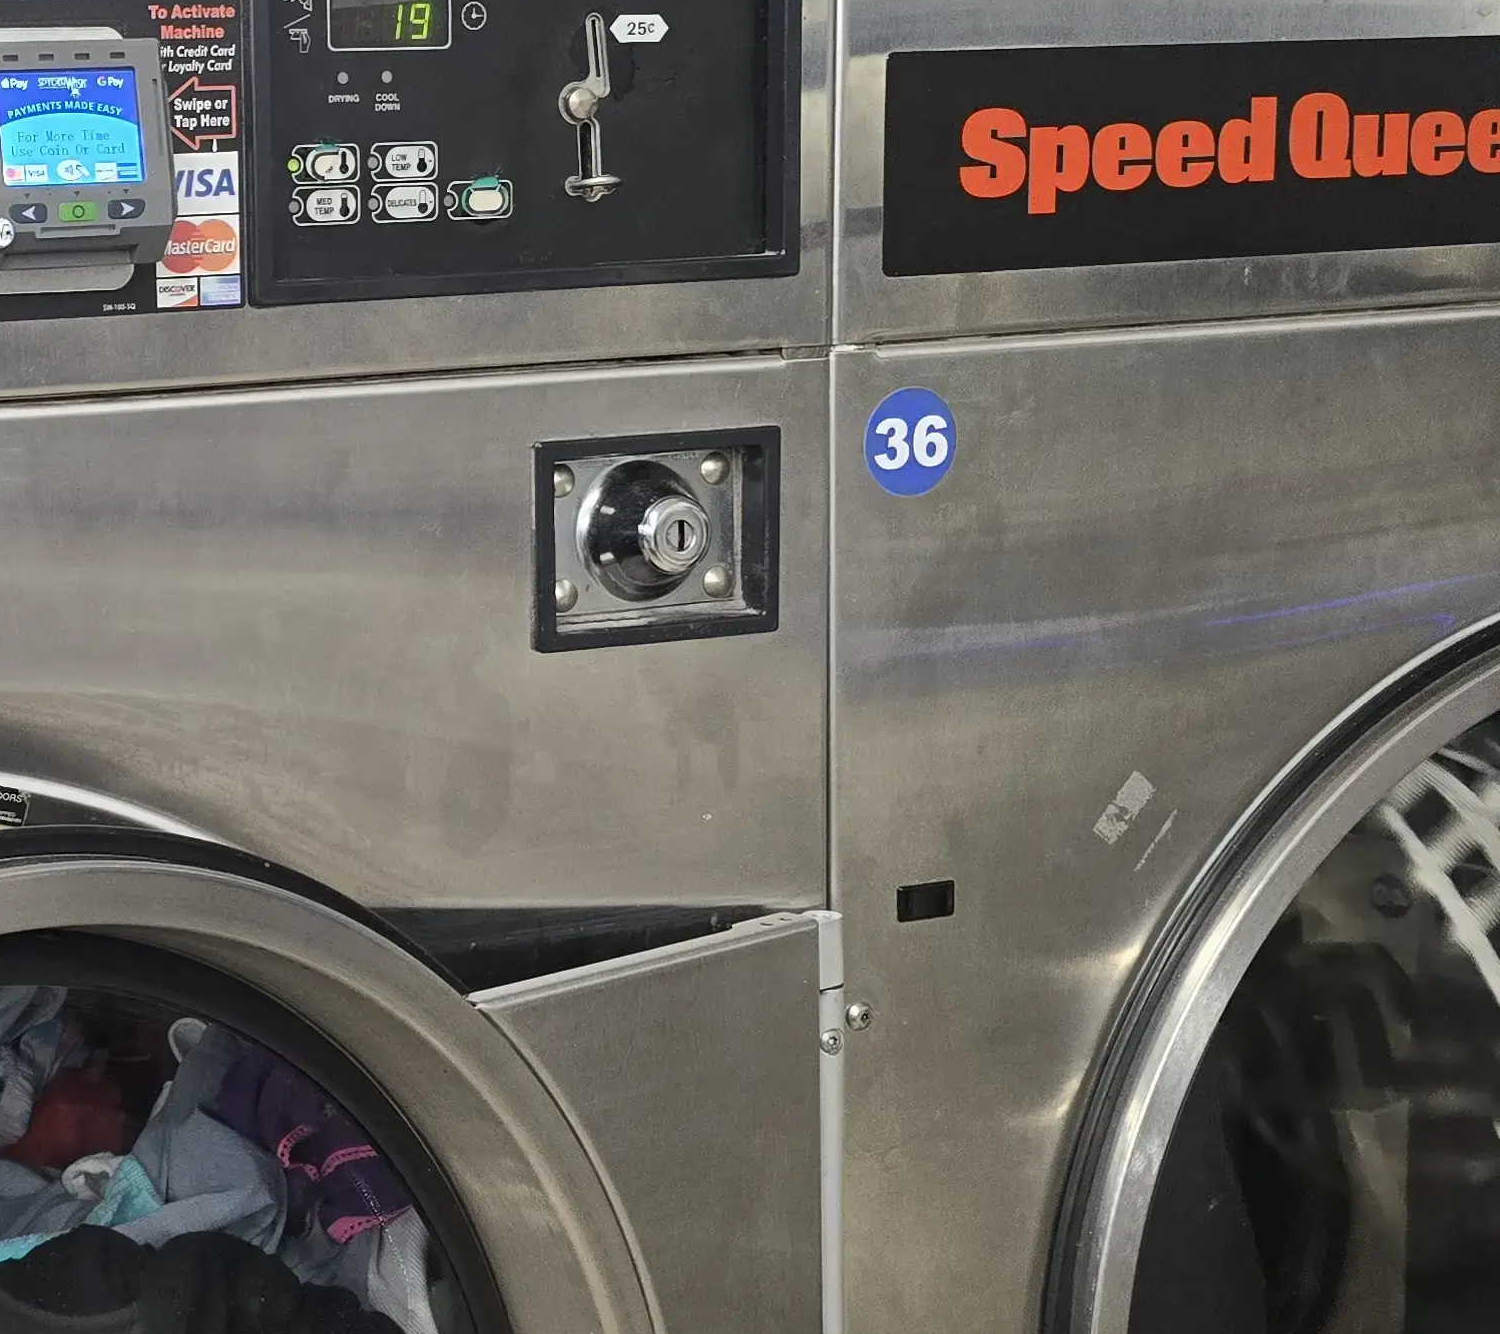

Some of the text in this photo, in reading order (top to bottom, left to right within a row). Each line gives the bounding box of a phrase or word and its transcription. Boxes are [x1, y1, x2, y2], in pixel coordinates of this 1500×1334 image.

[148, 4, 236, 19] To Activate
[395, 3, 431, 40] 19
[160, 25, 225, 39] Machine
[160, 44, 236, 58] ith Credit Card
[168, 60, 205, 74] Loyalty
[207, 58, 232, 71] Card
[328, 94, 360, 103] DRYING
[375, 93, 399, 101] COOL
[8, 100, 123, 119] PAYMENTS MADE EASY
[174, 98, 228, 113] Swipe or
[375, 103, 400, 112] DOWN
[174, 114, 230, 130] Tap Here
[17, 129, 109, 142] For More Time
[11, 143, 125, 156] Use Coin Or Card
[958, 92, 1500, 214] Speed Quee
[391, 154, 407, 162] LOW
[391, 163, 411, 171] TEMP
[316, 198, 333, 206] MED
[388, 199, 417, 207] DELICATES
[314, 207, 335, 215] TEMP
[158, 284, 195, 293] DISCOVER
[874, 415, 949, 470] 36
